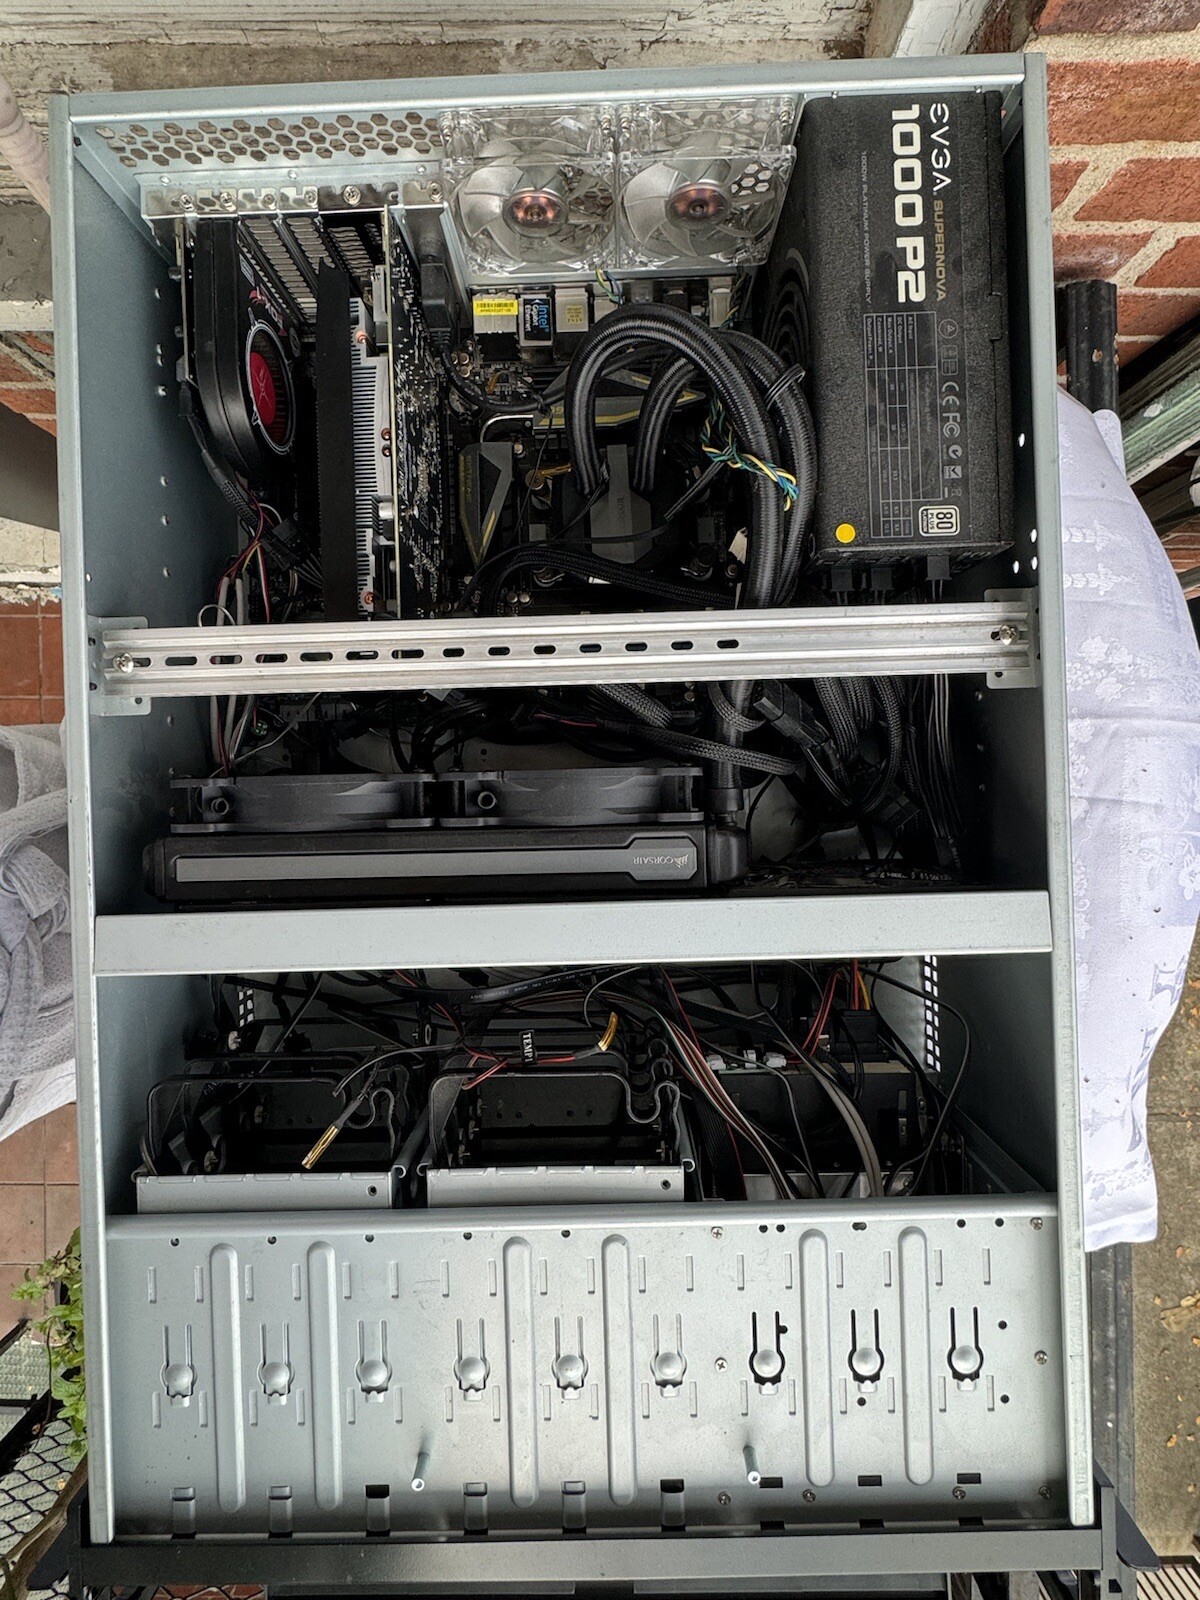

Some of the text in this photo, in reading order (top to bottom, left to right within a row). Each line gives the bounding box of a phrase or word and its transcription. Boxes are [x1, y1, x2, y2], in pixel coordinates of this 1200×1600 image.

[861, 151, 872, 304] 1000W PLATINUM POWER SUPPLY
[892, 103, 926, 304] 1000 P2
[930, 103, 951, 301] EVGA SUPERNOVA
[936, 512, 954, 530] 80
[633, 855, 674, 865] CORSAIR
